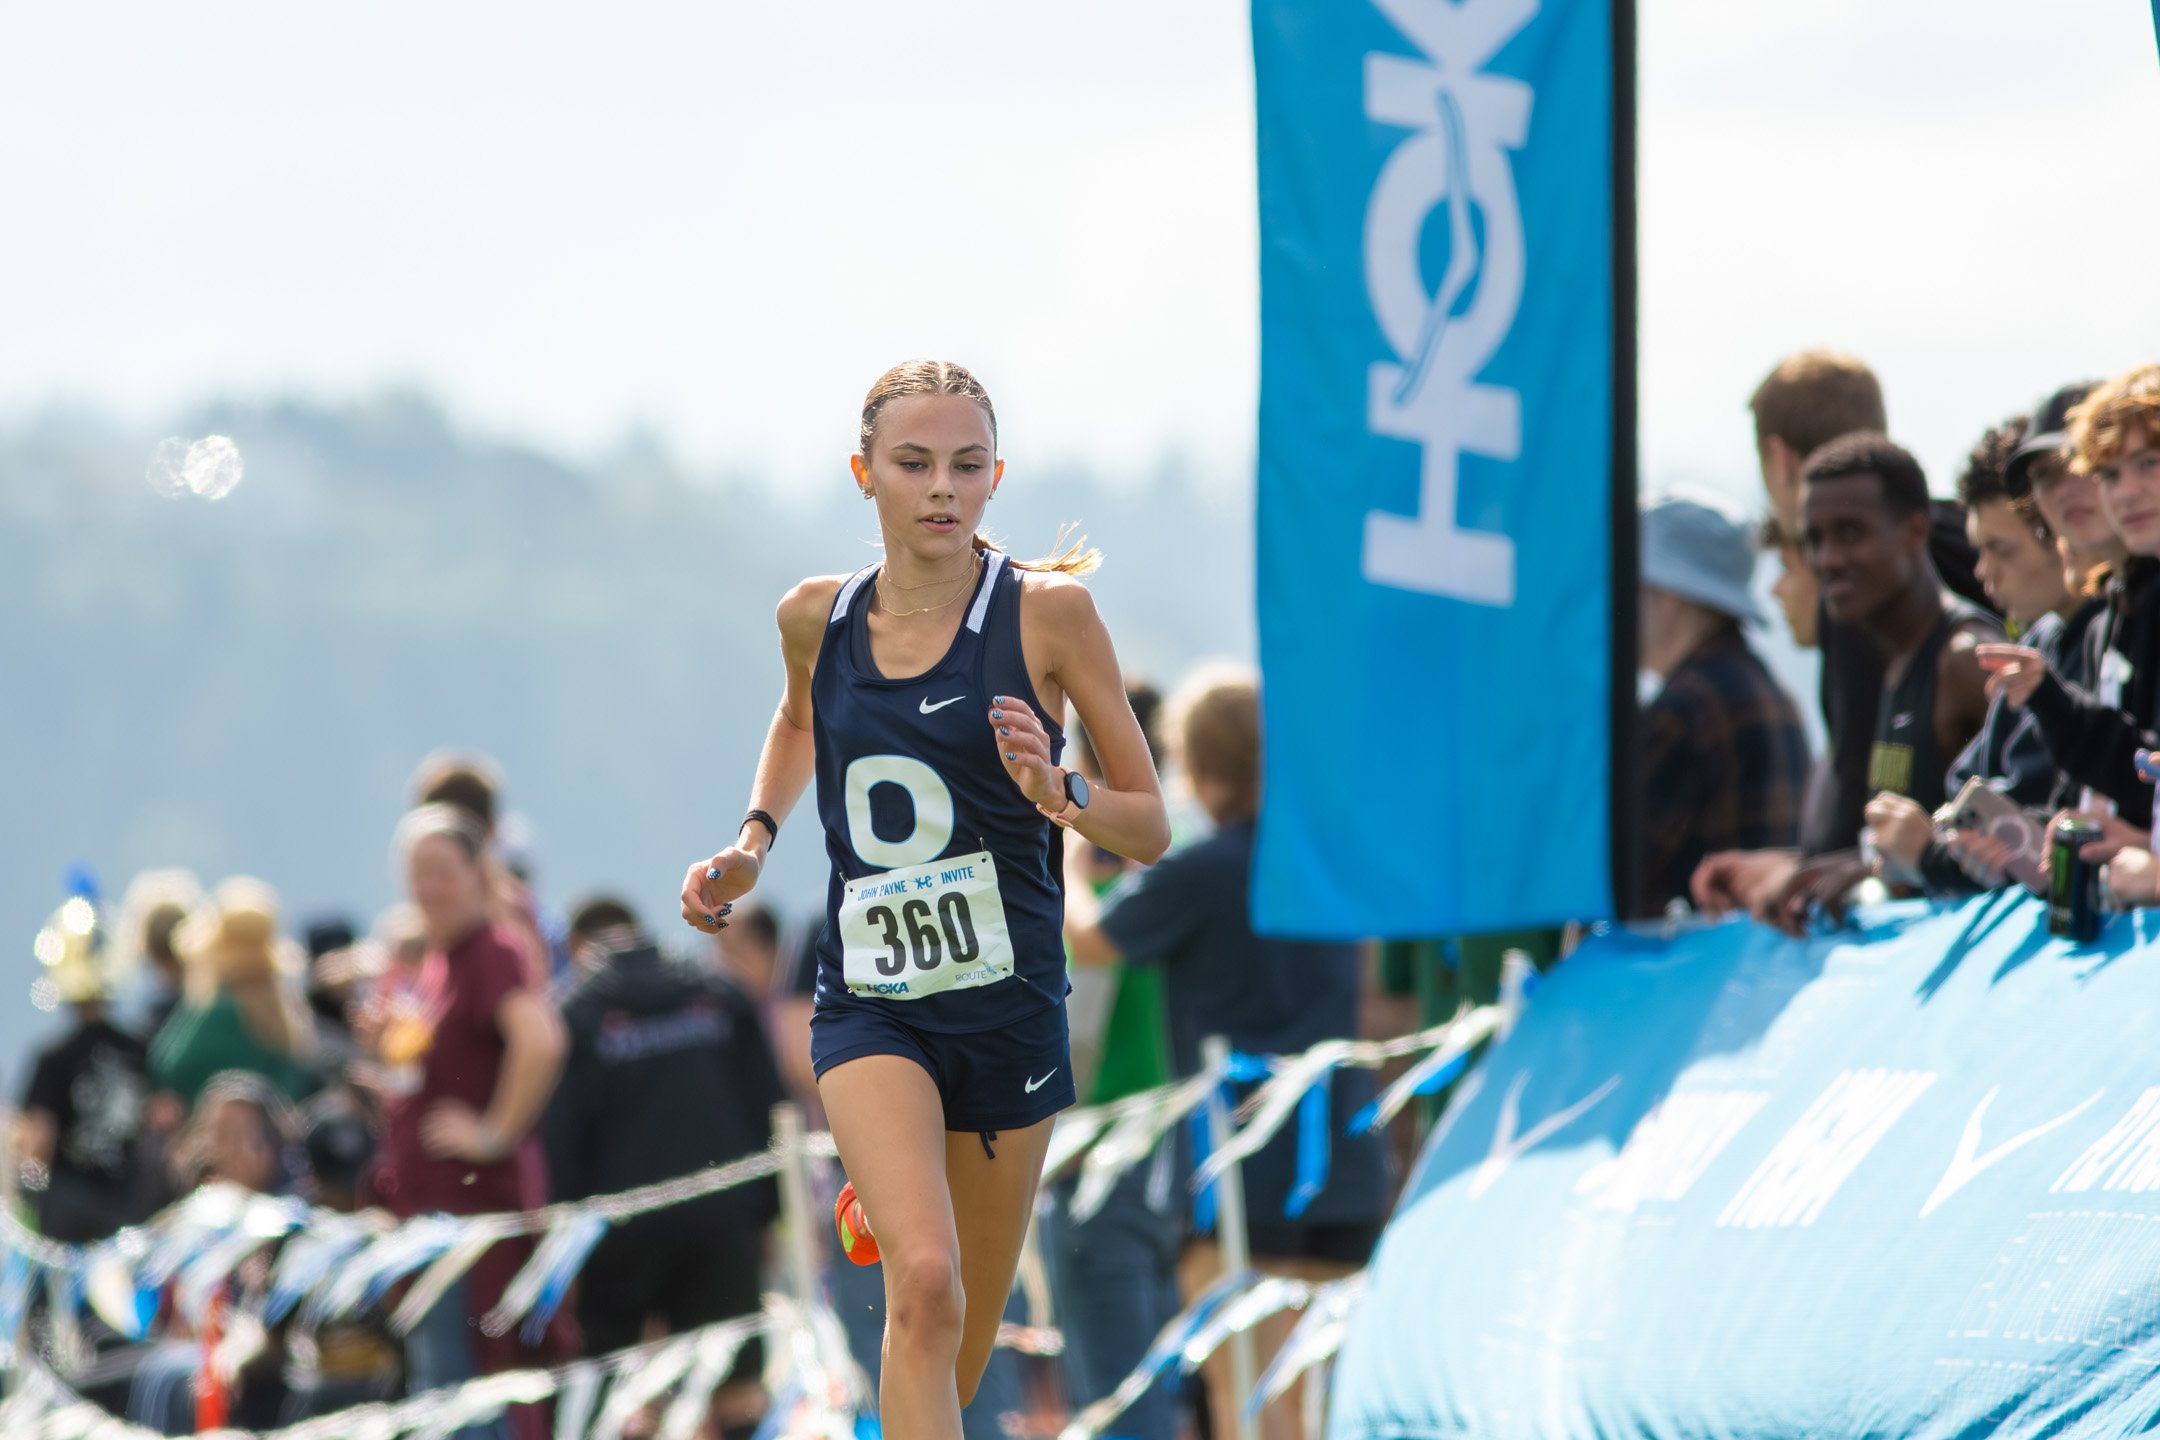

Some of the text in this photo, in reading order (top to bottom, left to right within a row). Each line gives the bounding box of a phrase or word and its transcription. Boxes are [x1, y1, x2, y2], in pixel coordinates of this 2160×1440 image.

[845, 755, 954, 868] O
[858, 886, 879, 901] JOHN
[879, 880, 907, 897] PAYNE
[941, 866, 975, 884] INVITE
[866, 892, 979, 976] 360
[867, 982, 909, 994] HOKA
